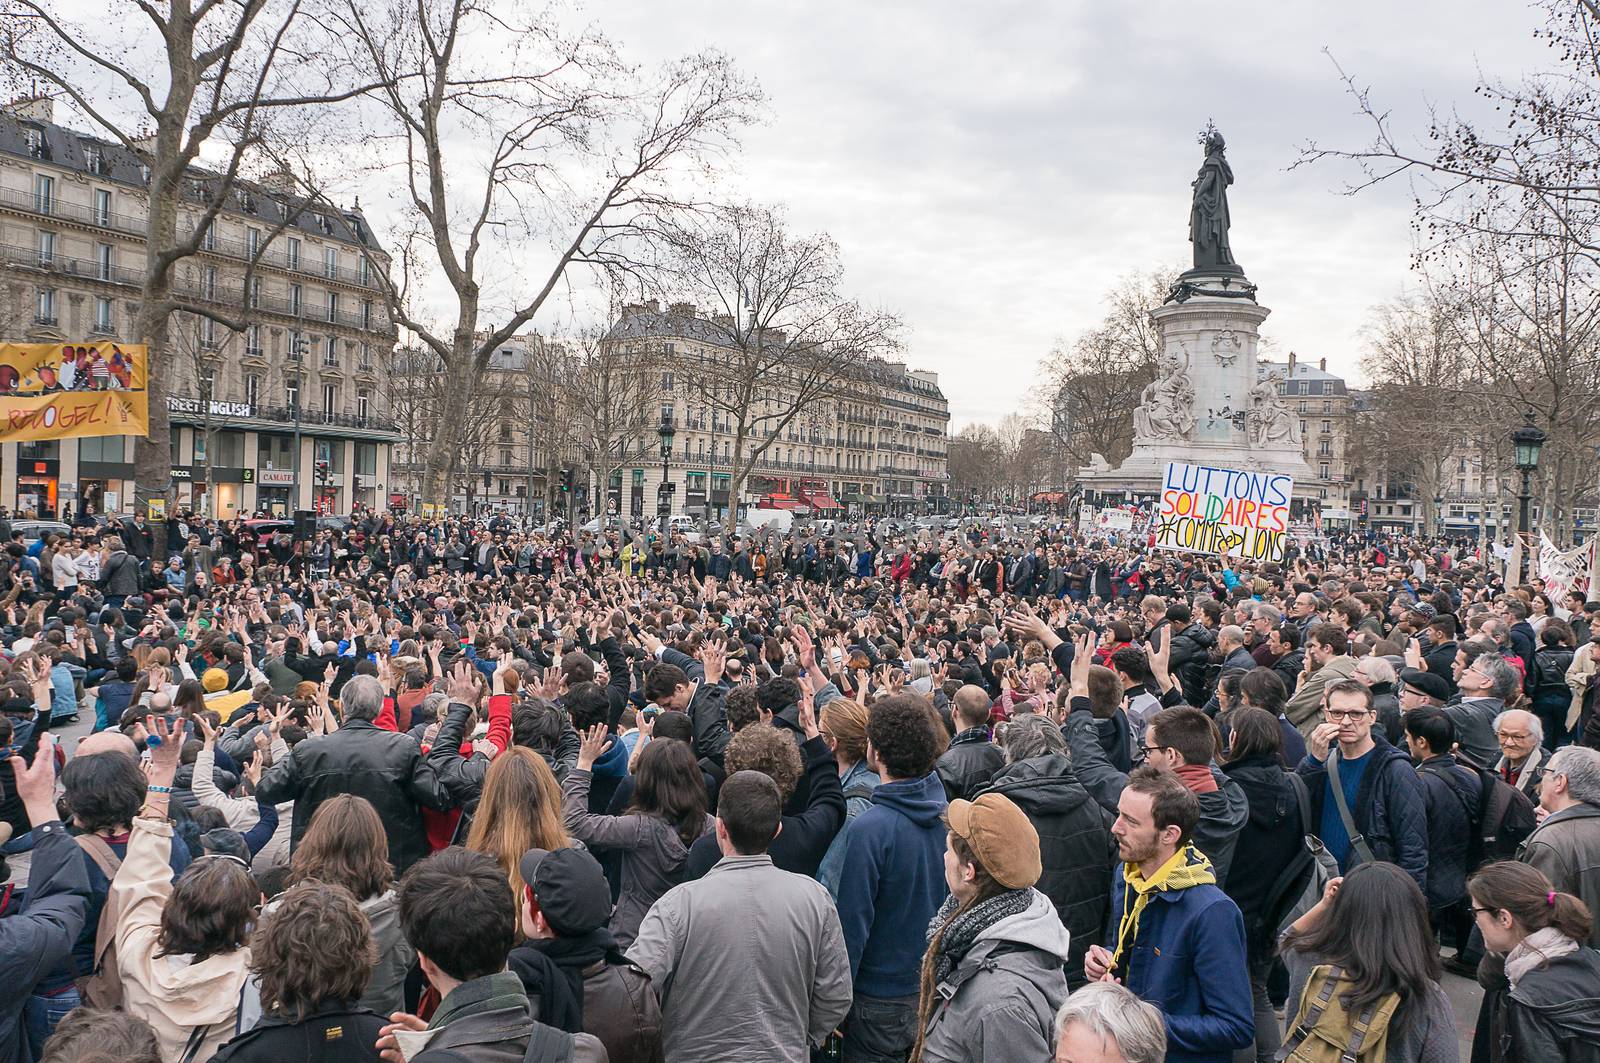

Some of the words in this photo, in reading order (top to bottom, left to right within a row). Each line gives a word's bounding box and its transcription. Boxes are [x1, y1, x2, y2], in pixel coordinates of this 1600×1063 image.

[166, 396, 200, 412] TREET
[1167, 463, 1291, 506] LUTTONS
[1161, 490, 1288, 533] SOLIDAIRES
